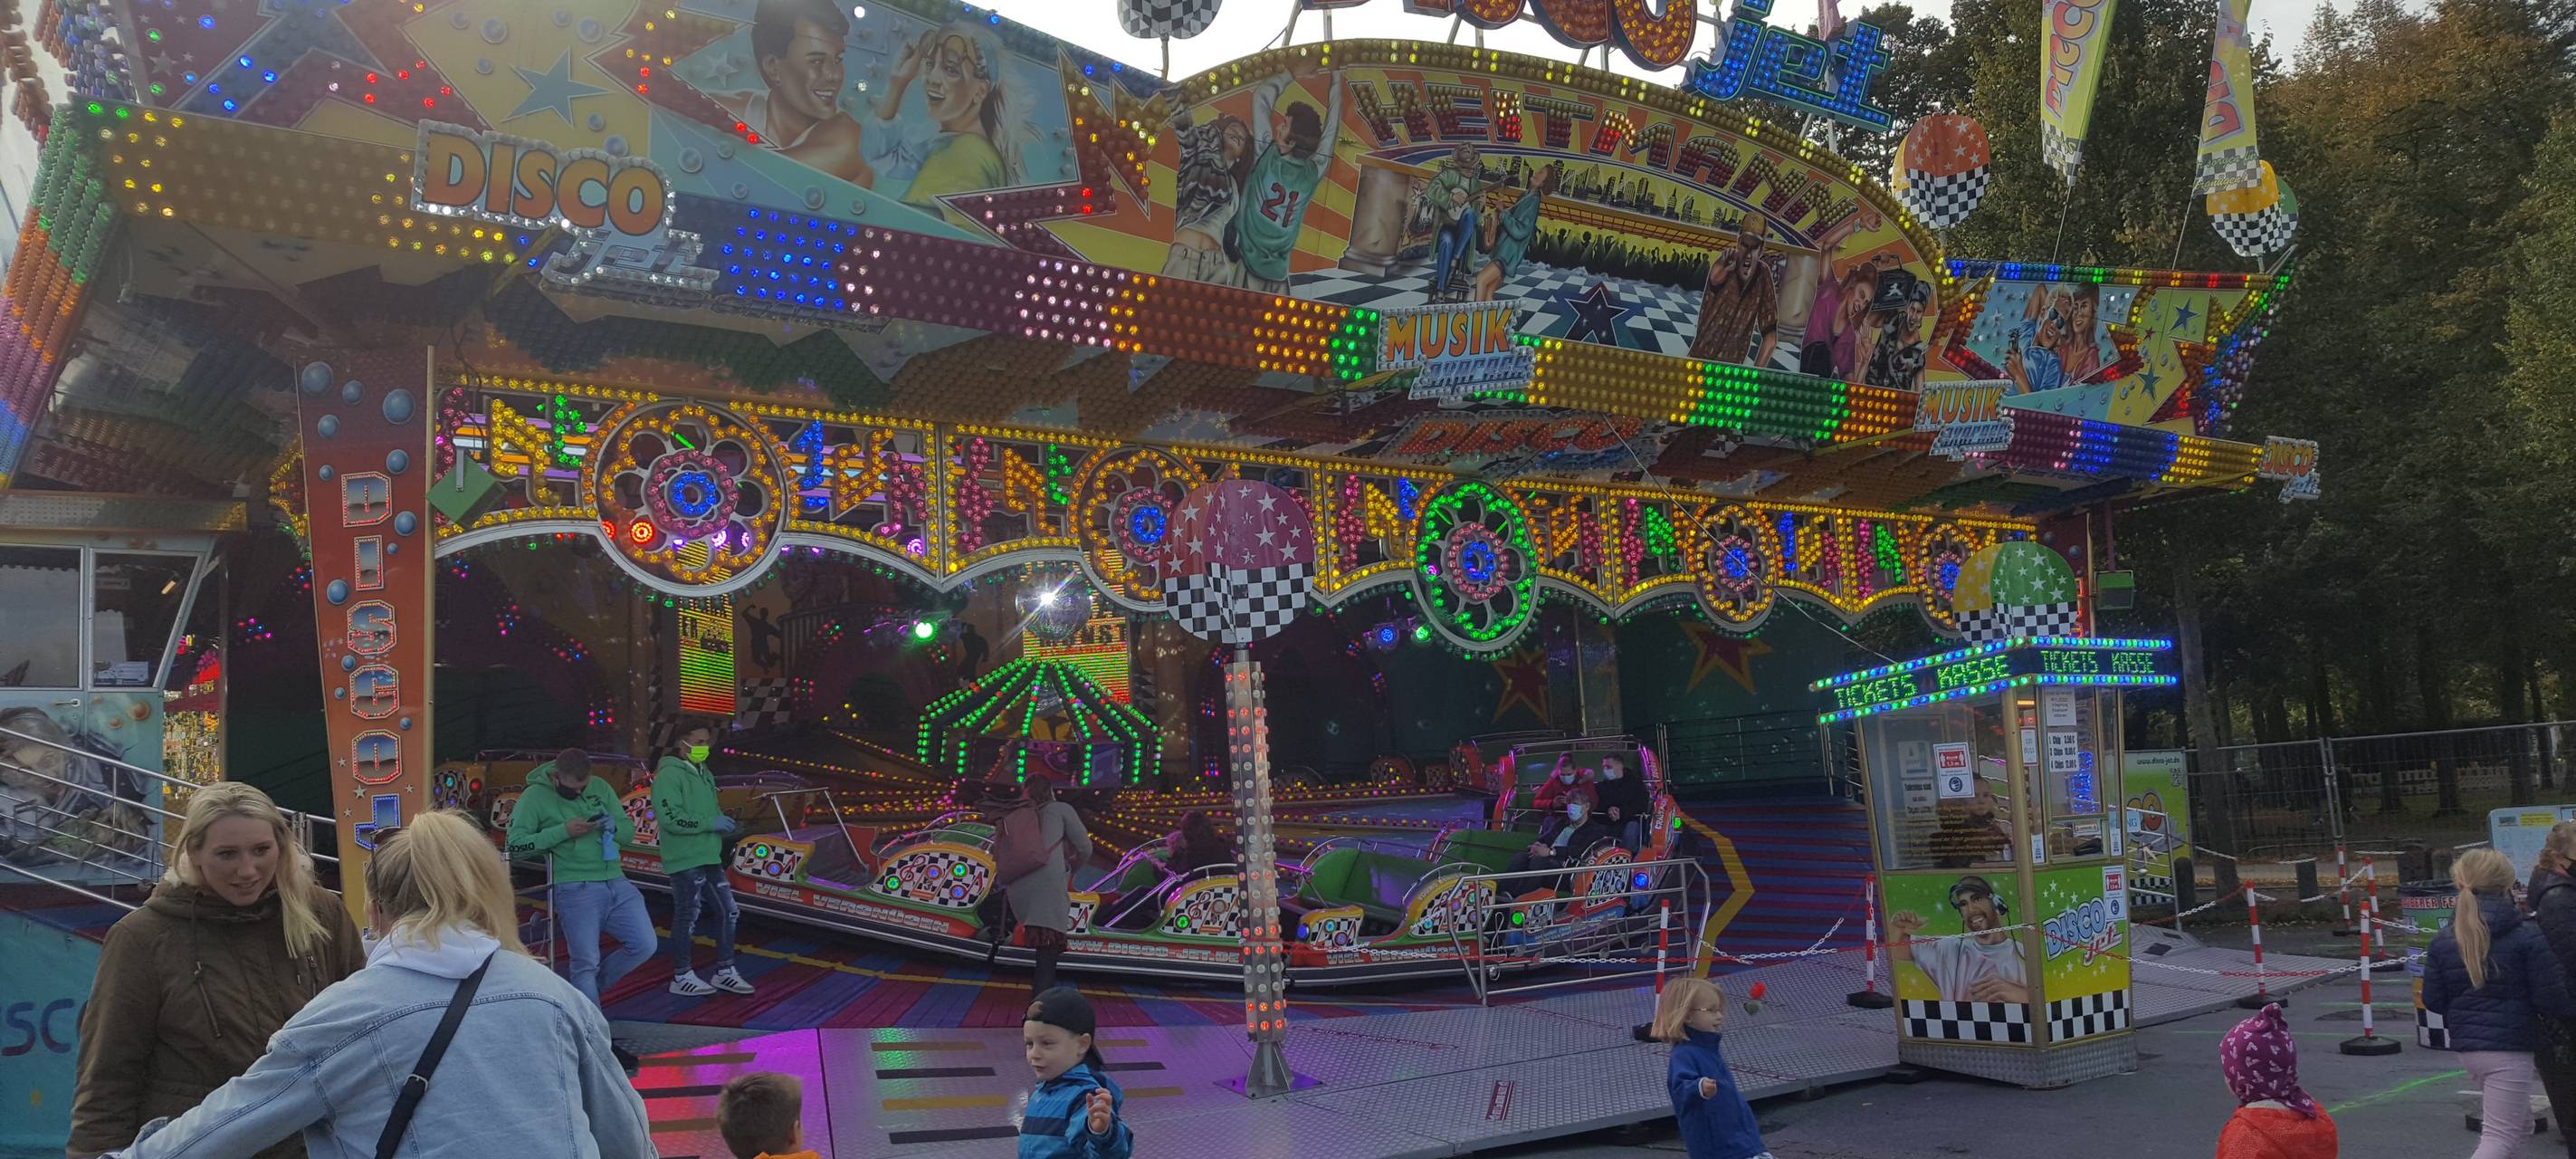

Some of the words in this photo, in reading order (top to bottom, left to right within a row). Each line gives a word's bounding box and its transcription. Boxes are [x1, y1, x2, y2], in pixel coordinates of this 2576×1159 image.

[1693, 0, 1892, 129] jet
[422, 134, 664, 235] DISCO
[1347, 80, 1858, 243] HEITMANN
[1260, 182, 1300, 226] 21
[1386, 308, 1513, 362] MUSIK
[1922, 387, 2004, 424] MUSIK
[341, 471, 403, 786] DISCO
[1834, 673, 1918, 709] TICKETS
[1937, 655, 2011, 690] KASSE
[2041, 650, 2100, 675] TICKETS
[2111, 652, 2155, 674] KASSE
[755, 882, 803, 903] VIEL
[813, 894, 949, 934] VERGNÜGEN
[2044, 900, 2105, 957] DISCO
[1067, 939, 1240, 963] WW.DISCO-JET.DE
